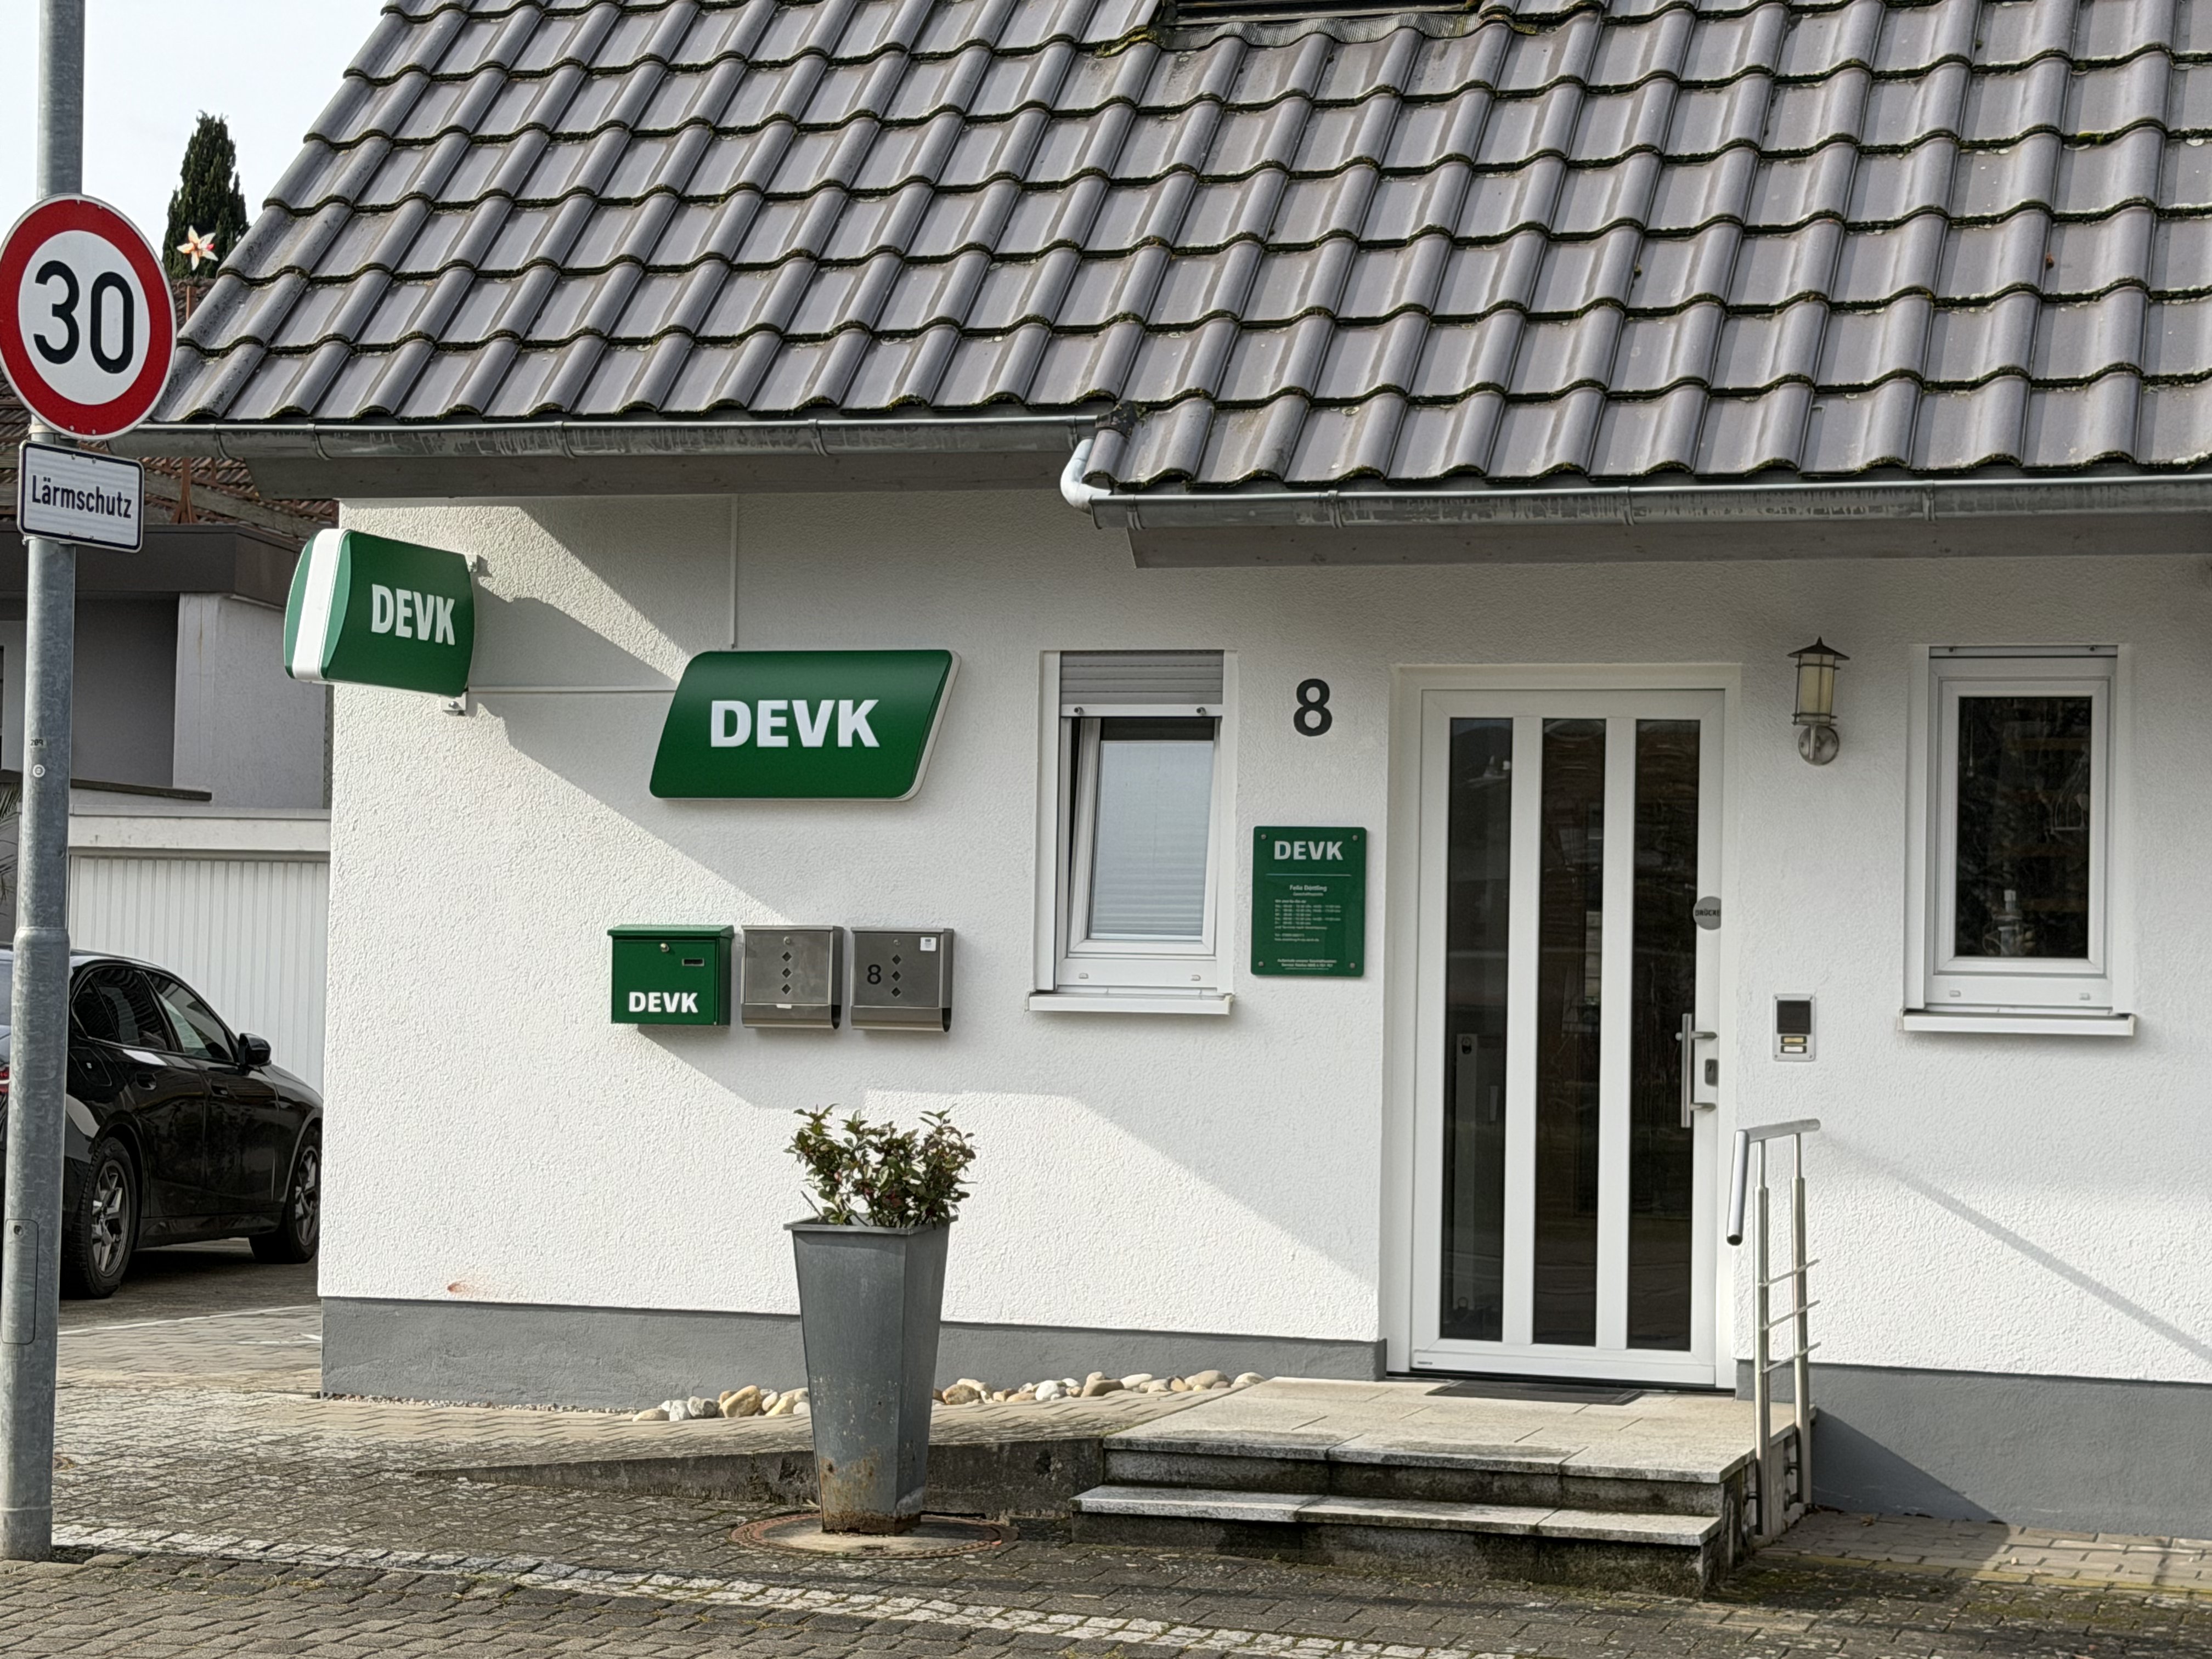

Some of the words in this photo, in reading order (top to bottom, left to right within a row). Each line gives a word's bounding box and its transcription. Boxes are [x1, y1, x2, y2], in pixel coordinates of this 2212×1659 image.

[33, 260, 134, 374] 30
[32, 475, 132, 519] Lärmschutz
[371, 583, 455, 646] DEVK
[710, 699, 880, 748] DEVK
[1293, 678, 1333, 737] 8
[1273, 840, 1344, 861] DEVK
[1695, 909, 1721, 917] DRÜCKE
[867, 964, 882, 985] 8
[629, 991, 699, 1013] DEVK
